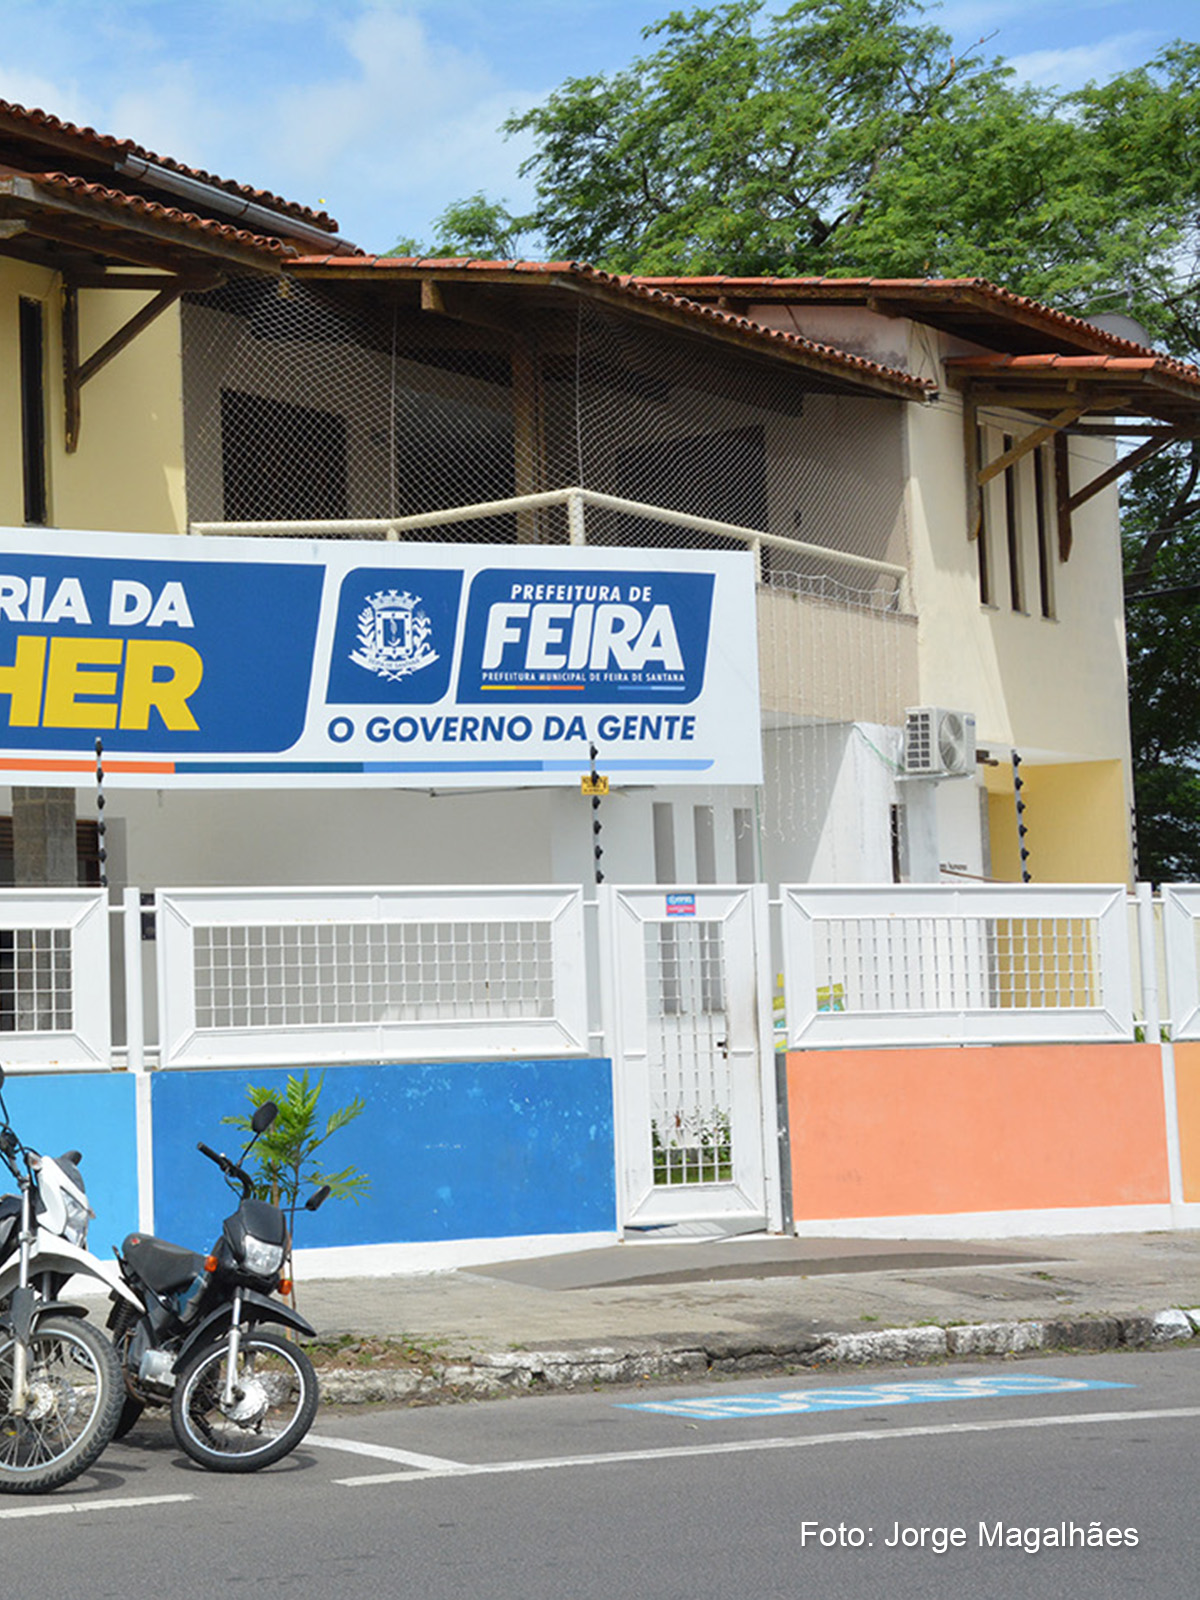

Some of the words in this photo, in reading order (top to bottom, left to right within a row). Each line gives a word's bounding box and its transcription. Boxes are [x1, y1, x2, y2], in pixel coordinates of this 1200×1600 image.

[109, 579, 194, 628] DA
[510, 584, 622, 602] PREFEITURA
[628, 586, 652, 602] DE
[481, 602, 686, 671] FEIRA
[482, 672, 536, 682] PREFEITURA
[539, 672, 587, 682] MUNICIPAL
[589, 672, 601, 682] DE
[603, 672, 629, 682] FEIRA
[631, 672, 643, 682] DE
[645, 672, 685, 683] SANTANA
[327, 716, 355, 743] O
[365, 715, 530, 743] GOVERNO
[542, 715, 588, 741] DA
[597, 715, 697, 741] GENTE
[640, 1376, 1088, 1417] IDOSO
